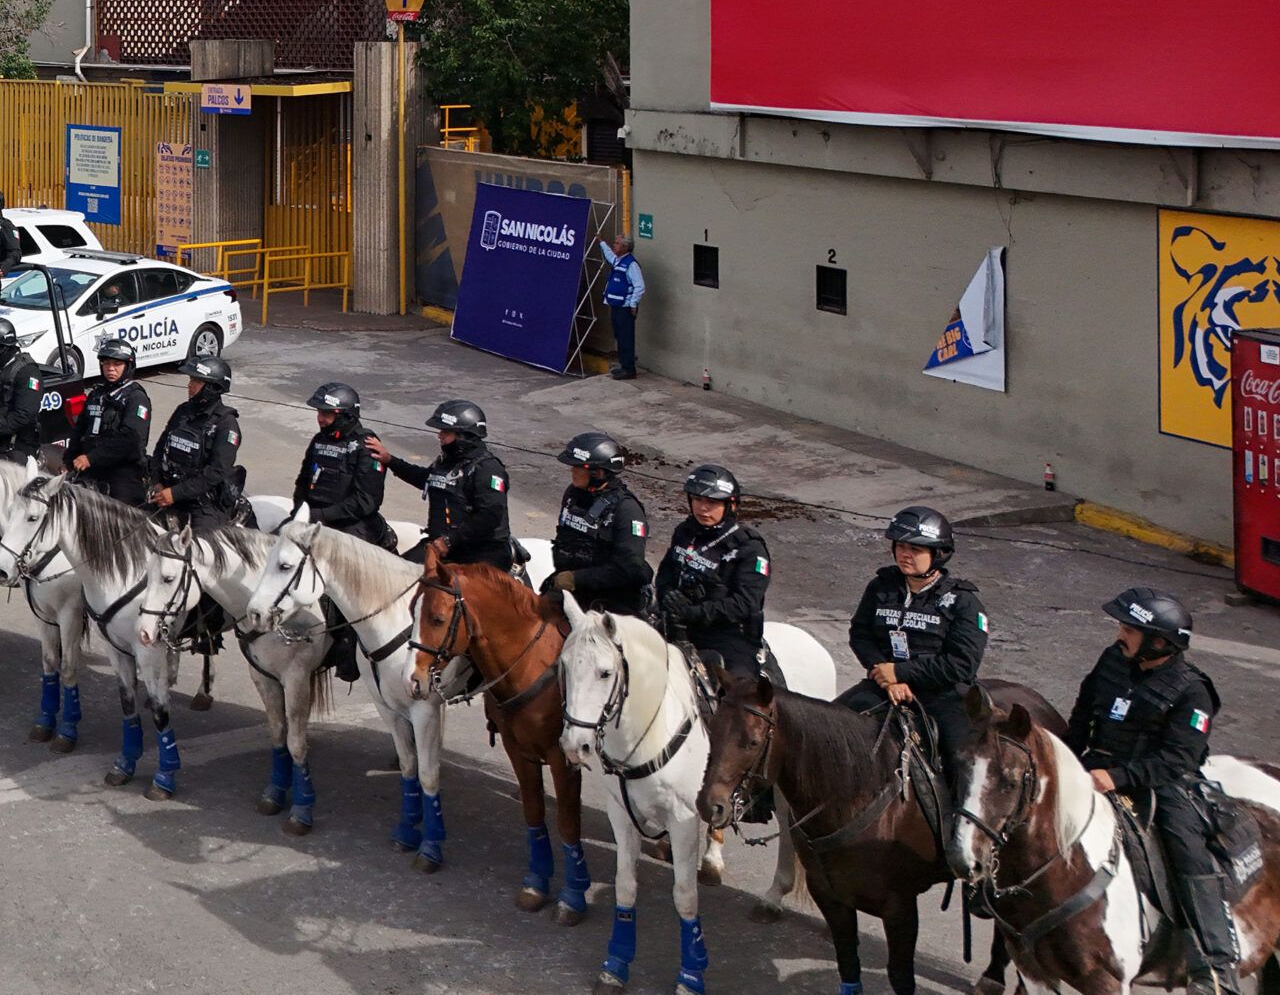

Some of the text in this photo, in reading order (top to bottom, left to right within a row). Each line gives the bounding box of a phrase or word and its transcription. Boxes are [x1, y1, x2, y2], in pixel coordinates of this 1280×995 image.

[207, 94, 229, 106] PALCOS
[500, 219, 576, 247] SAN NICOLÁS
[703, 229, 709, 242] 1
[497, 240, 571, 260] GOBIERNO DE LA CIUDAD
[827, 248, 837, 264] 2
[118, 316, 179, 342] POLICÍA
[945, 326, 962, 346] BIG
[142, 338, 178, 352] NICOLÁS
[937, 343, 959, 363] CARL
[40, 391, 62, 411] 49
[876, 608, 941, 625] FUERZAS SPECIALES
[886, 616, 927, 630] SAN ICOLAS
